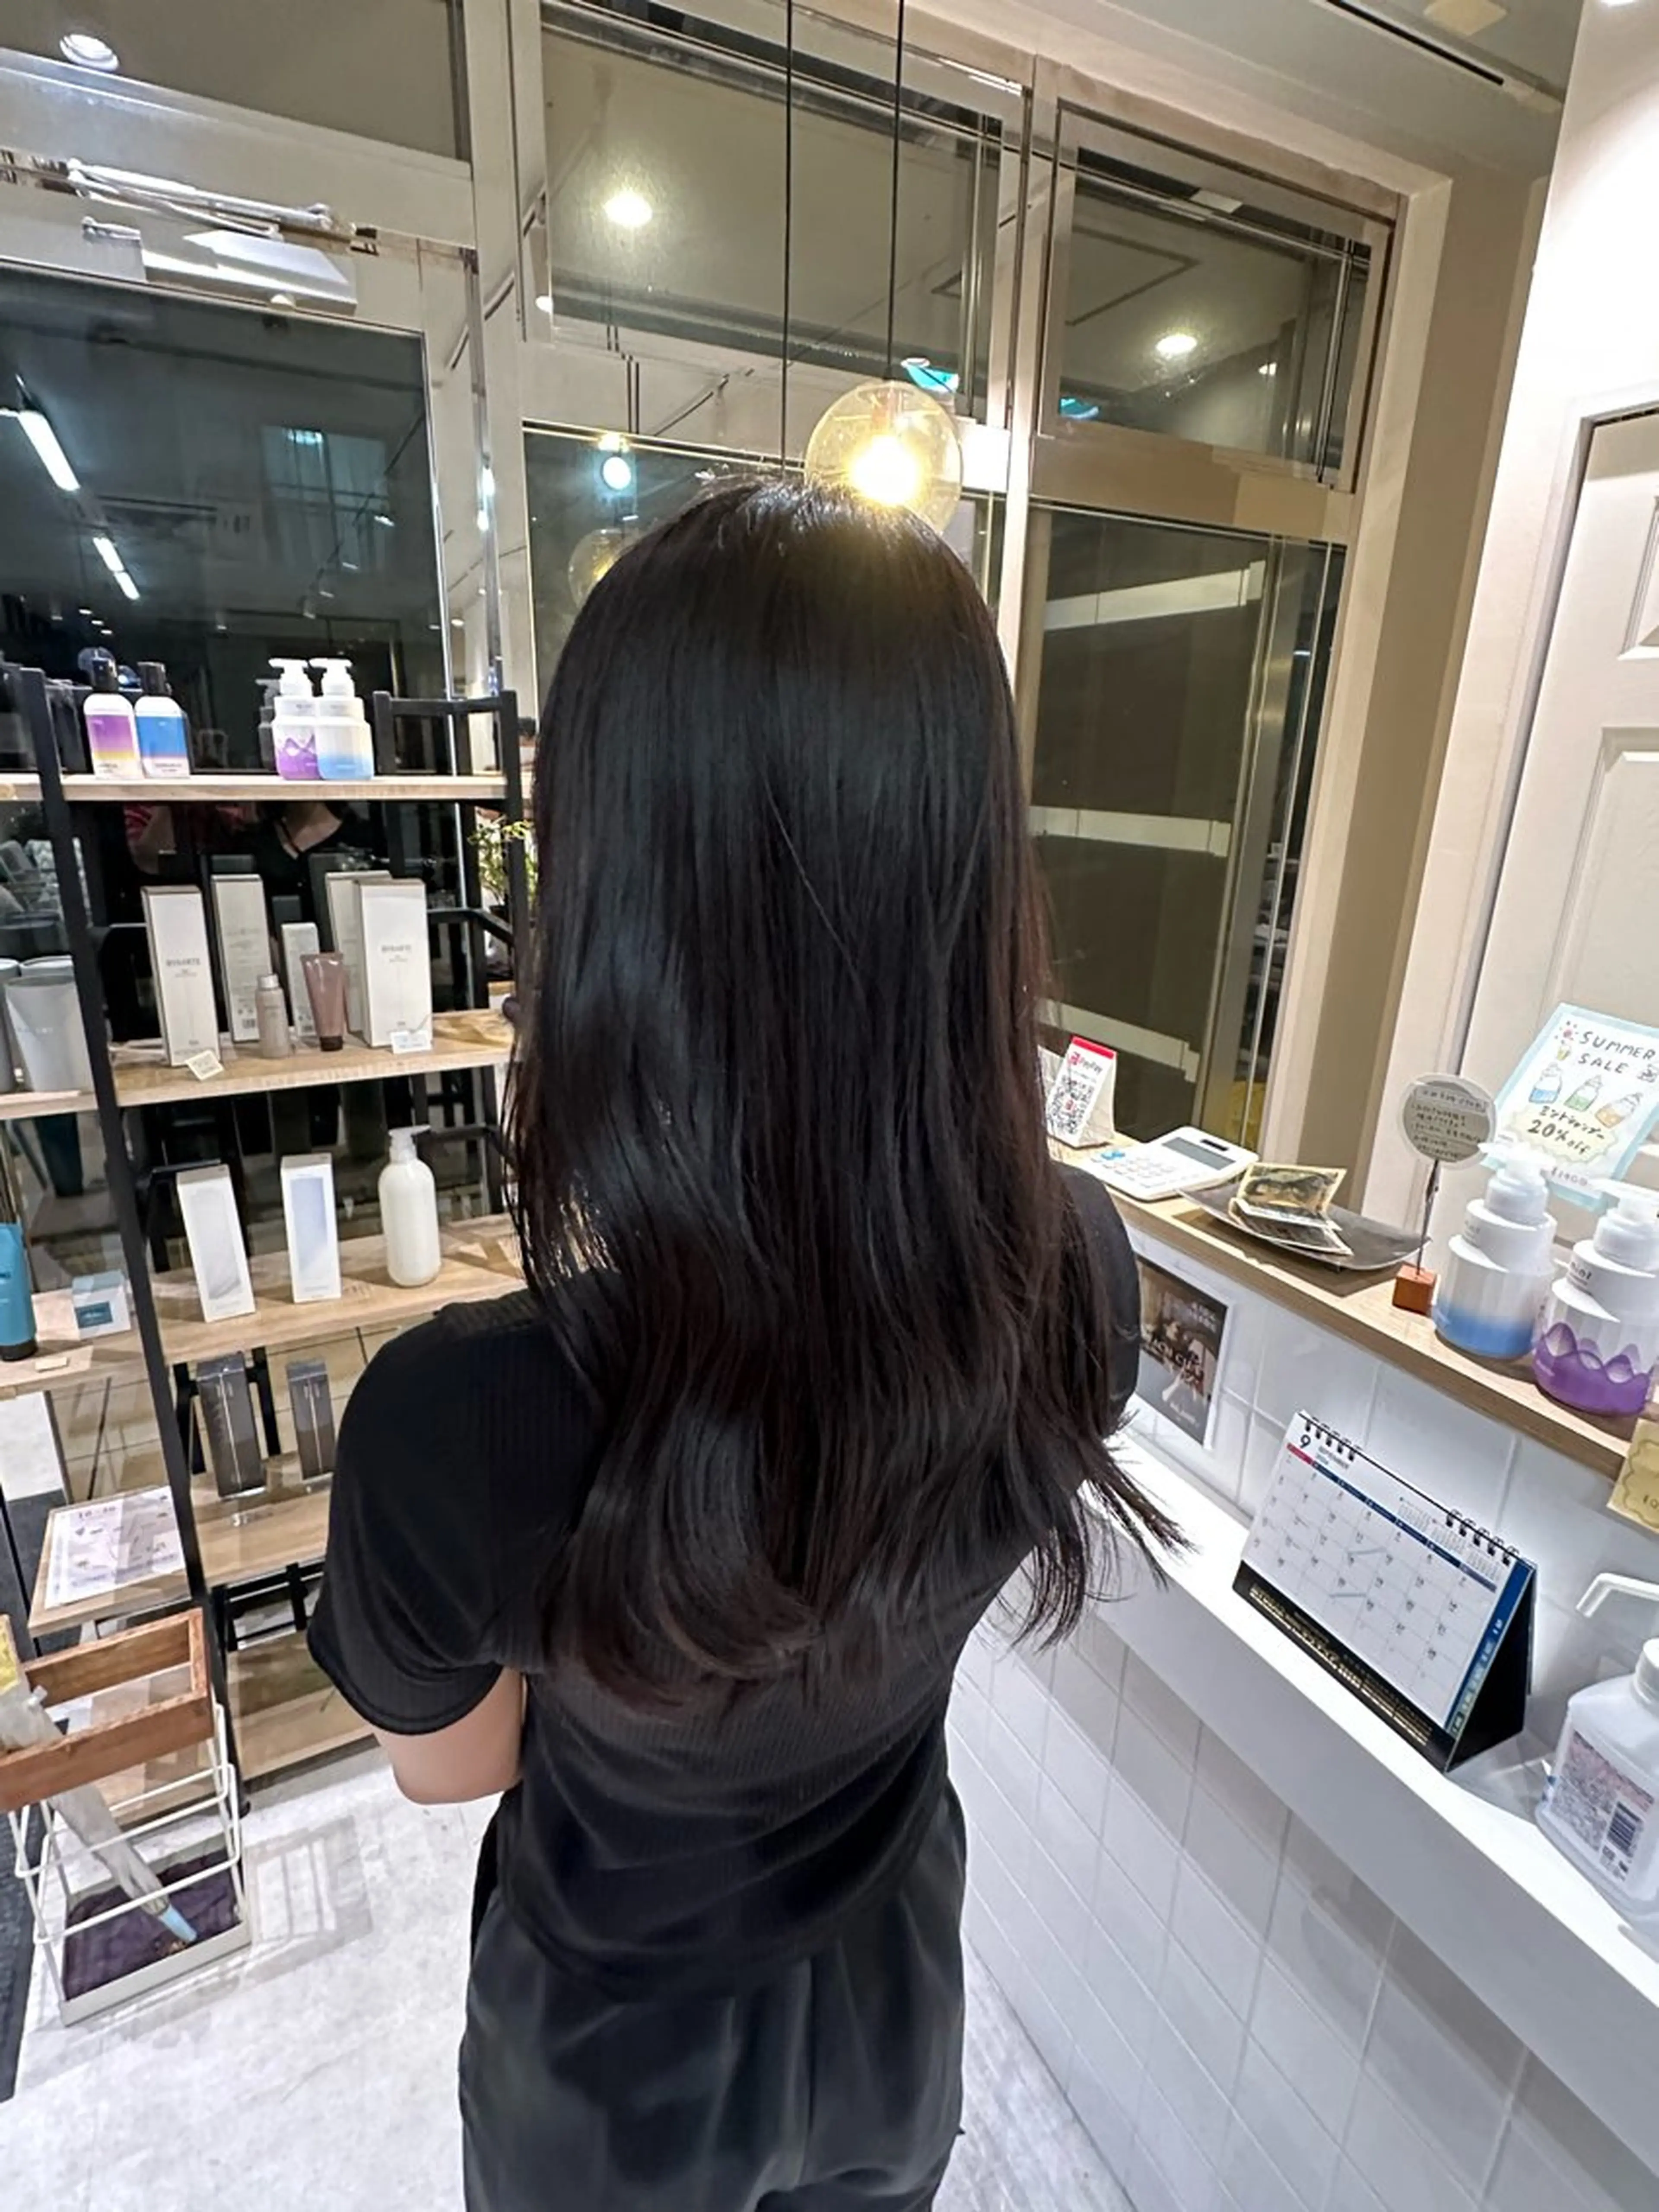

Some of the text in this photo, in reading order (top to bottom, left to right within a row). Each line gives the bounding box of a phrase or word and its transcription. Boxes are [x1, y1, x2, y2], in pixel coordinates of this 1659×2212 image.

[1580, 1031, 1656, 1060] SUMMER
[1578, 1053, 1629, 1074] SALE
[1527, 1119, 1591, 1154] 20% off
[1300, 1434, 1311, 1449] 9
